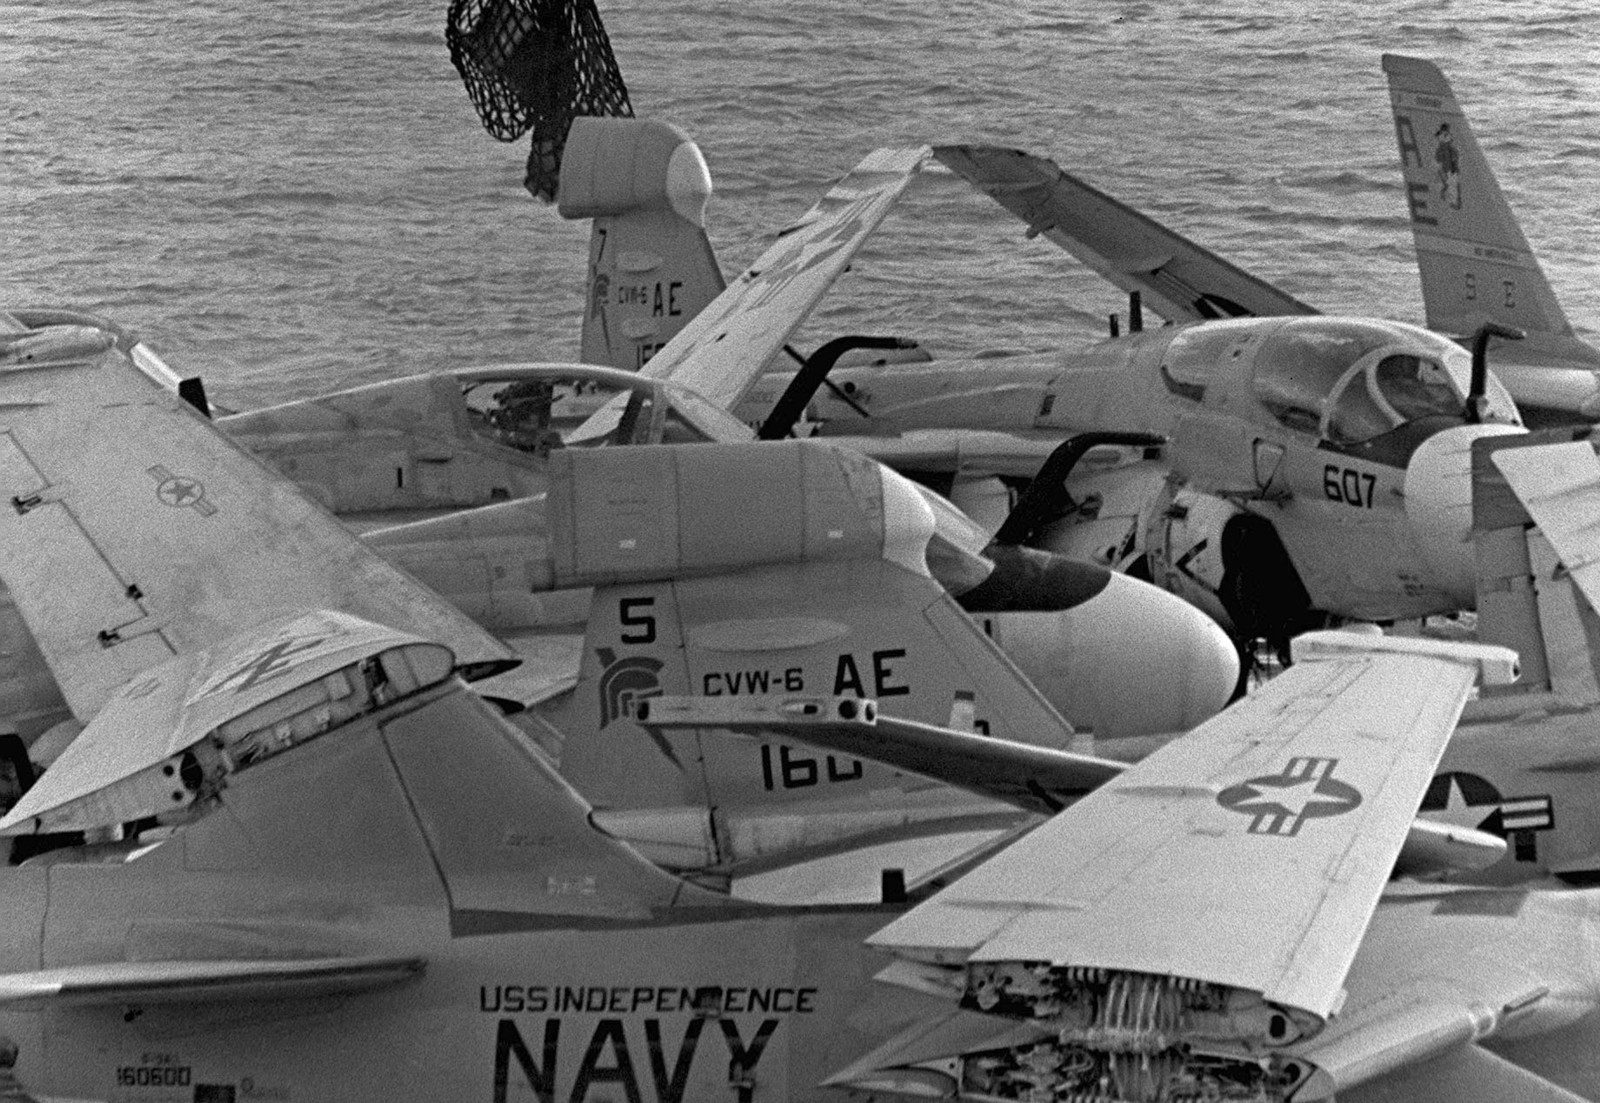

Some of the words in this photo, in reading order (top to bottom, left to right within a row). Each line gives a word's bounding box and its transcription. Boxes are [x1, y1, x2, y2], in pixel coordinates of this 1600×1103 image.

[652, 281, 683, 318] AE
[1324, 464, 1378, 509] 607
[620, 597, 656, 644] 5
[703, 668, 805, 697] CVW-6
[833, 648, 910, 698] AE
[554, 986, 818, 1013] INDEPENENCE
[117, 1066, 191, 1087] 160600
[494, 1018, 780, 1103] NAVY
